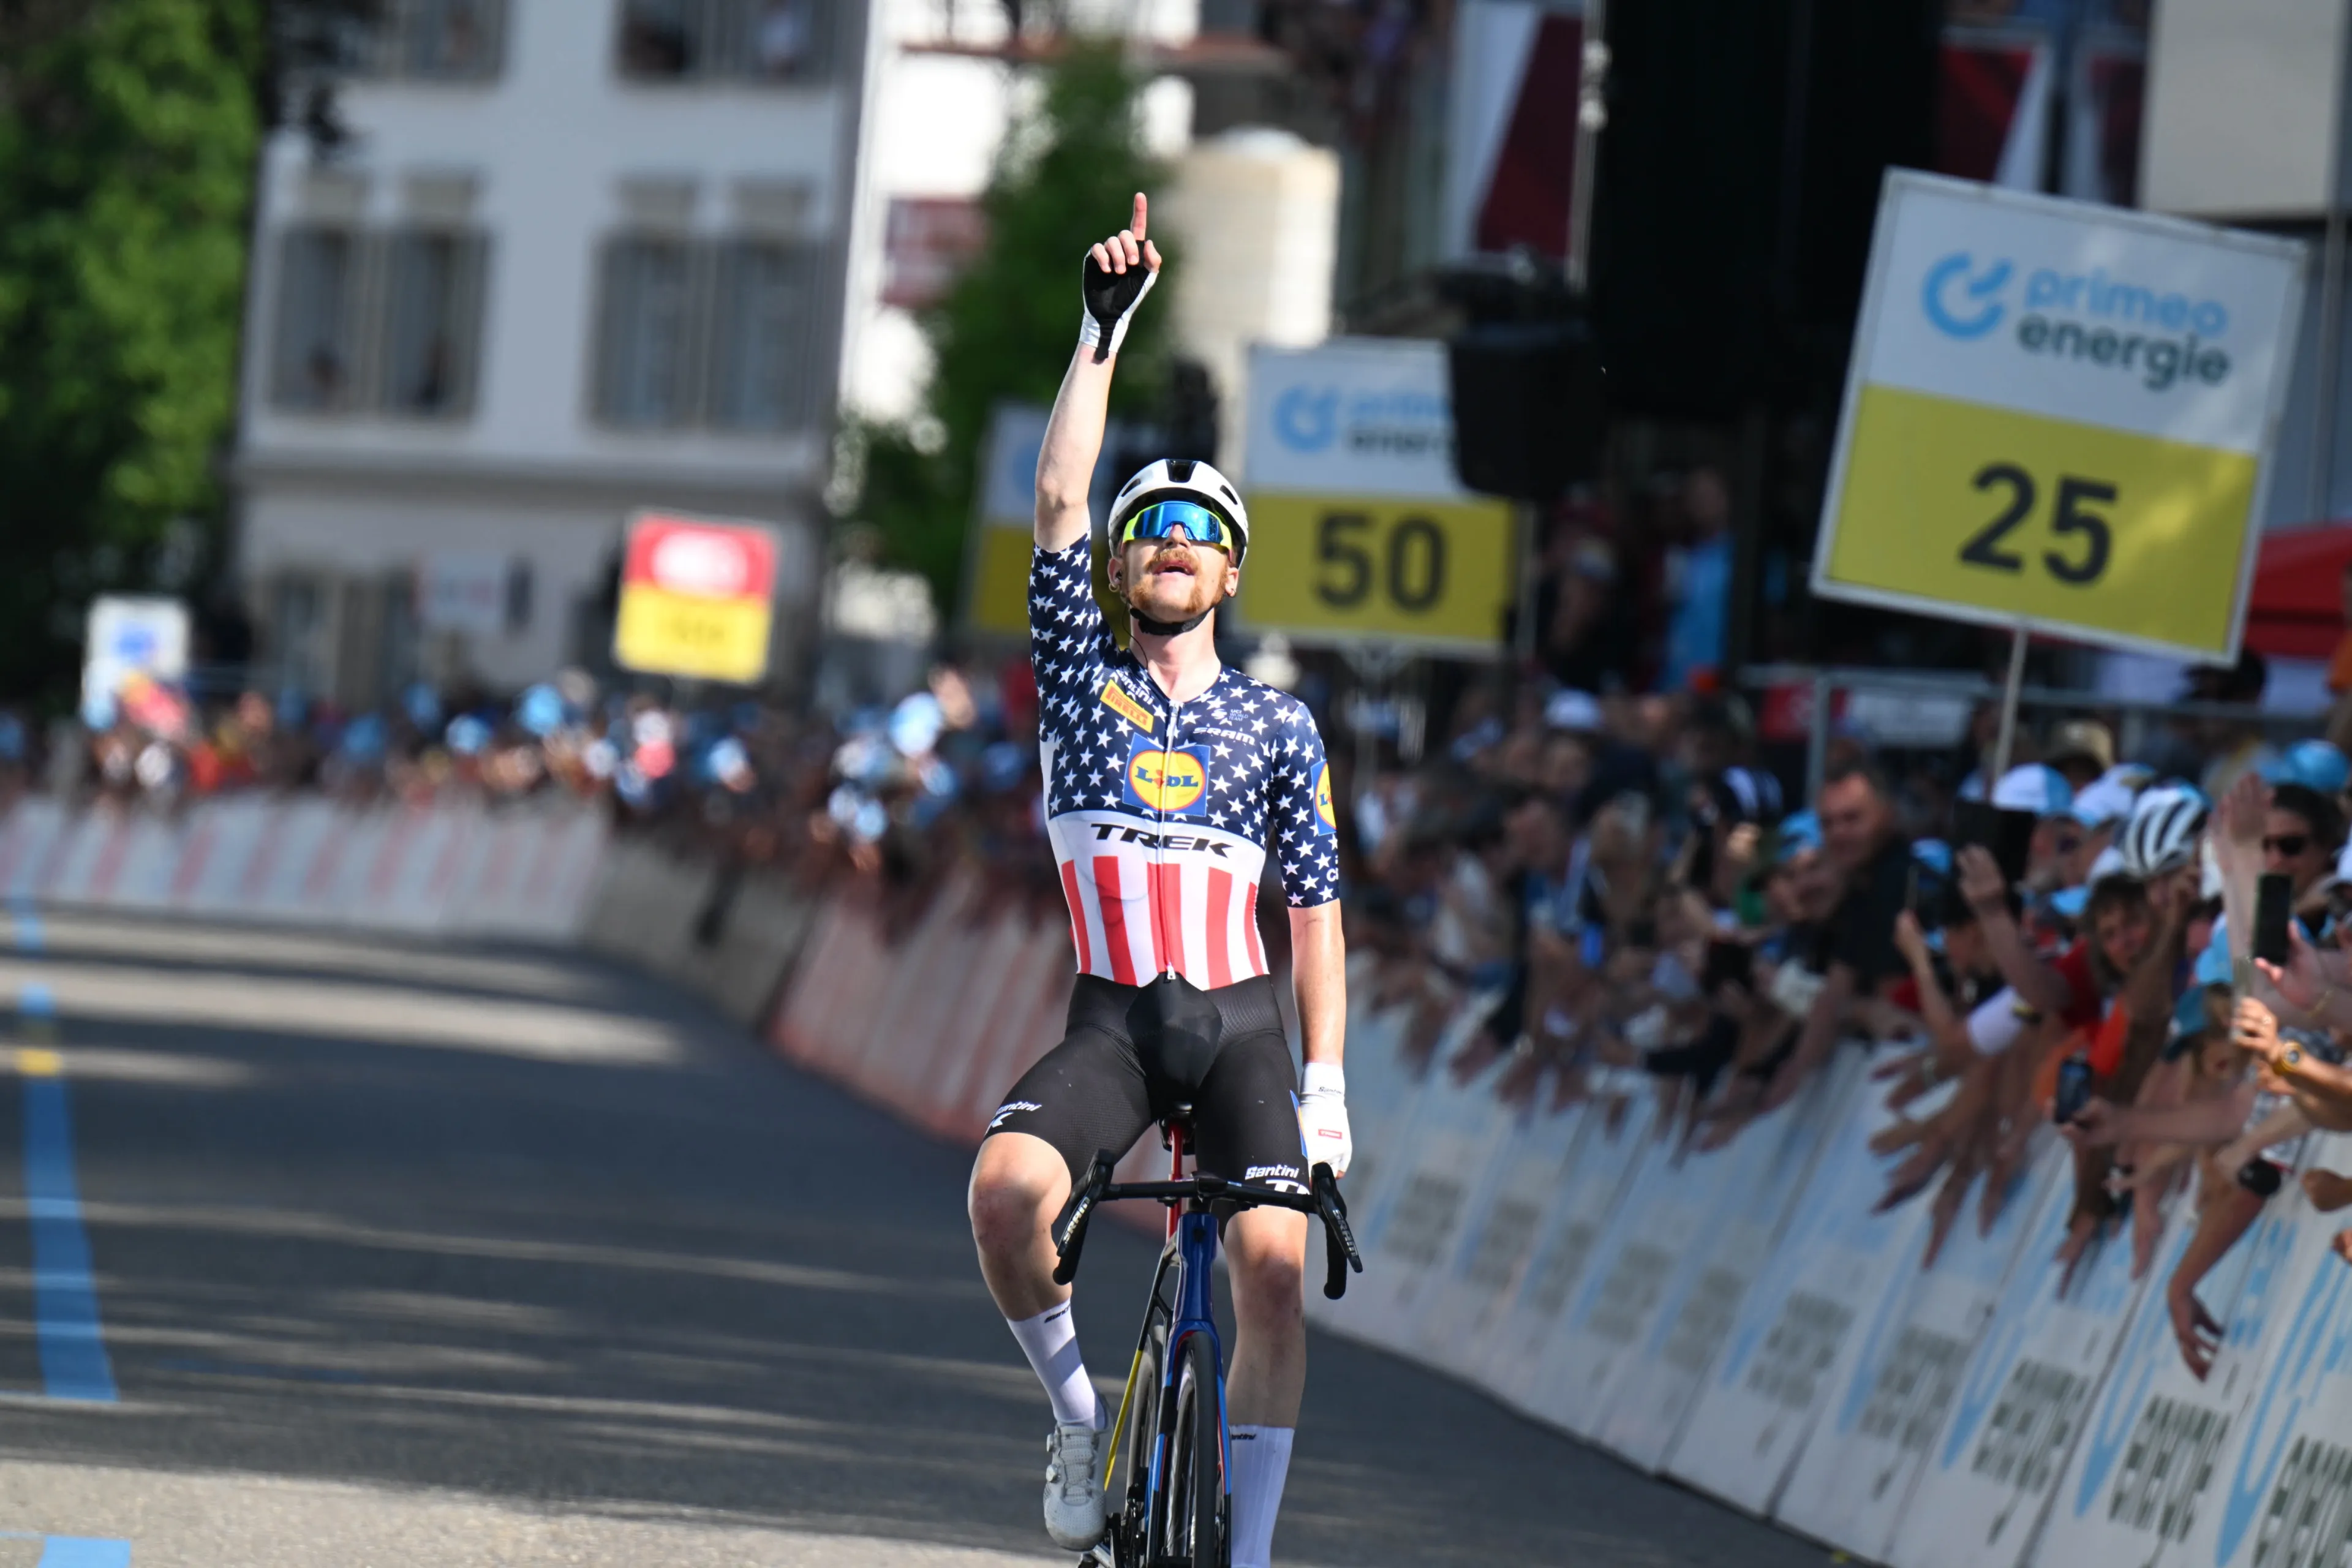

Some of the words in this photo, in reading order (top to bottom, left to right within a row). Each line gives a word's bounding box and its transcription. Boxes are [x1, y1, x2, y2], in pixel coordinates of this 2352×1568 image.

[2024, 265, 2230, 341] primeo
[2015, 311, 2233, 393] energie
[1958, 461, 2120, 589] 25
[1313, 510, 1448, 615] 50
[1105, 685, 1148, 726] PIRELLI
[1193, 727, 1256, 746] SRAM
[1090, 823, 1235, 859] TREK
[1245, 1164, 1300, 1180] Santini
